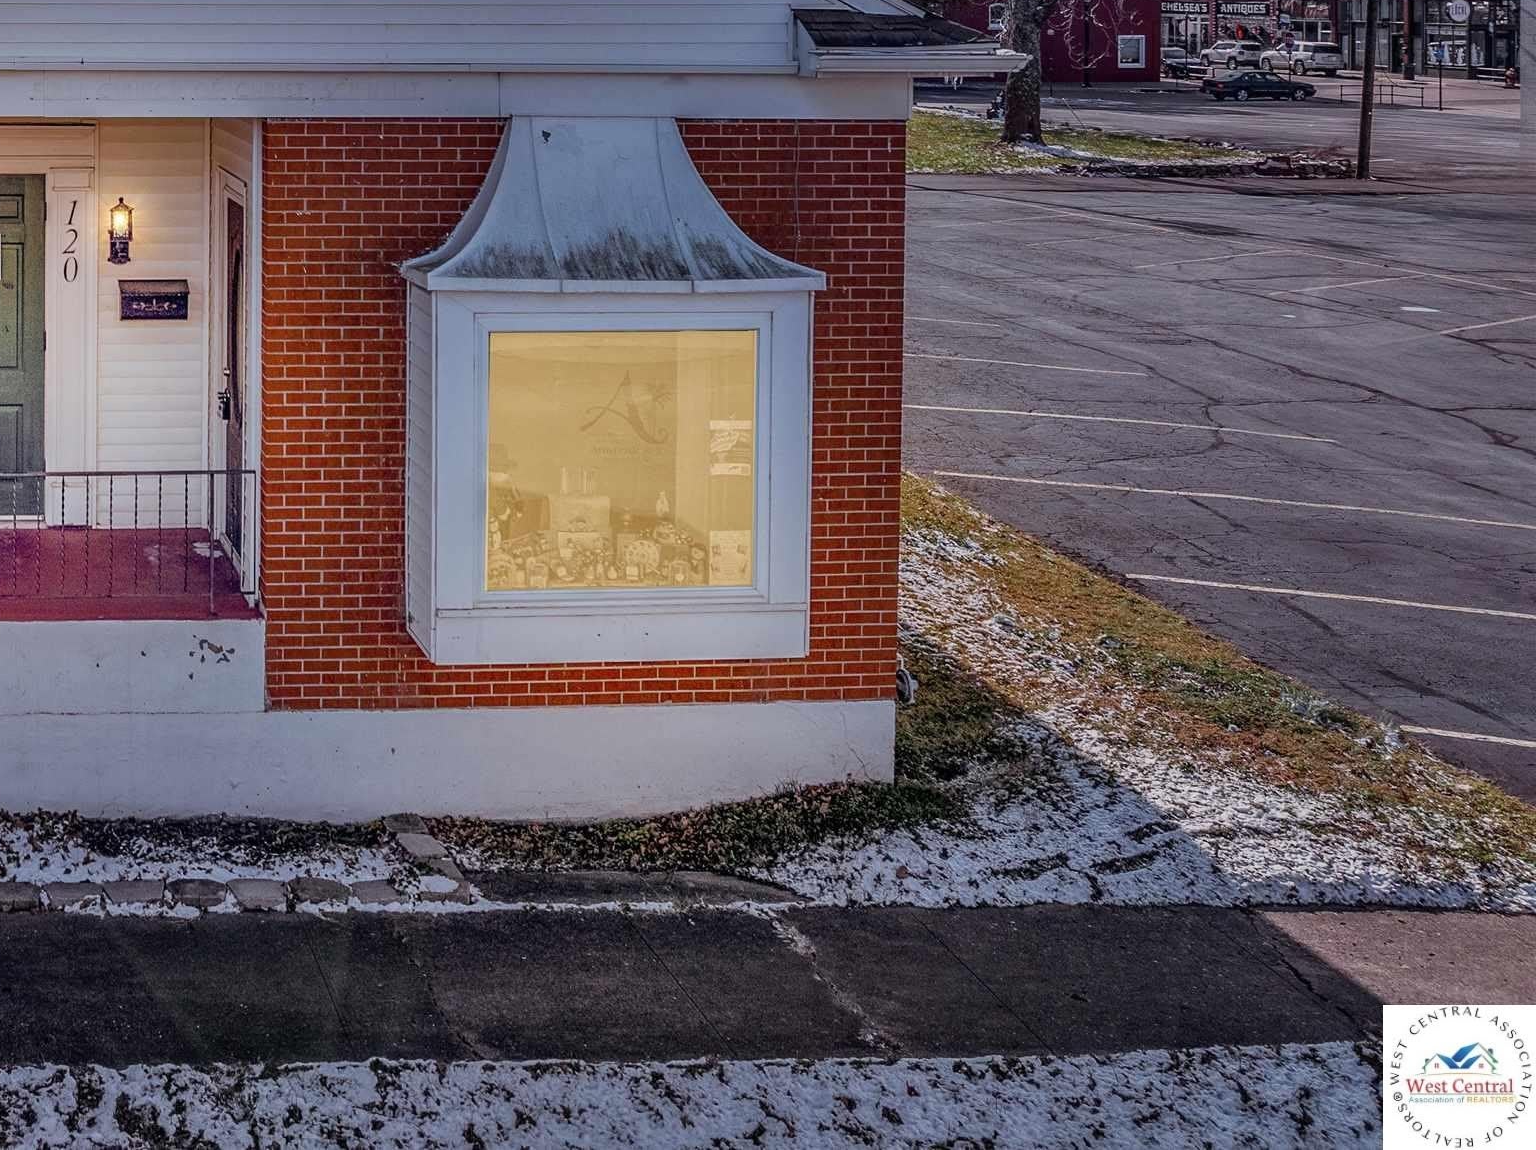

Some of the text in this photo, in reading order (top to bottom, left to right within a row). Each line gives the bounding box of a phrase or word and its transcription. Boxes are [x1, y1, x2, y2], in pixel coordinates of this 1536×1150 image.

[1161, 2, 1208, 13] CHELSEA'S
[1220, 3, 1266, 15] ANTIQUES
[62, 200, 78, 283] 120
